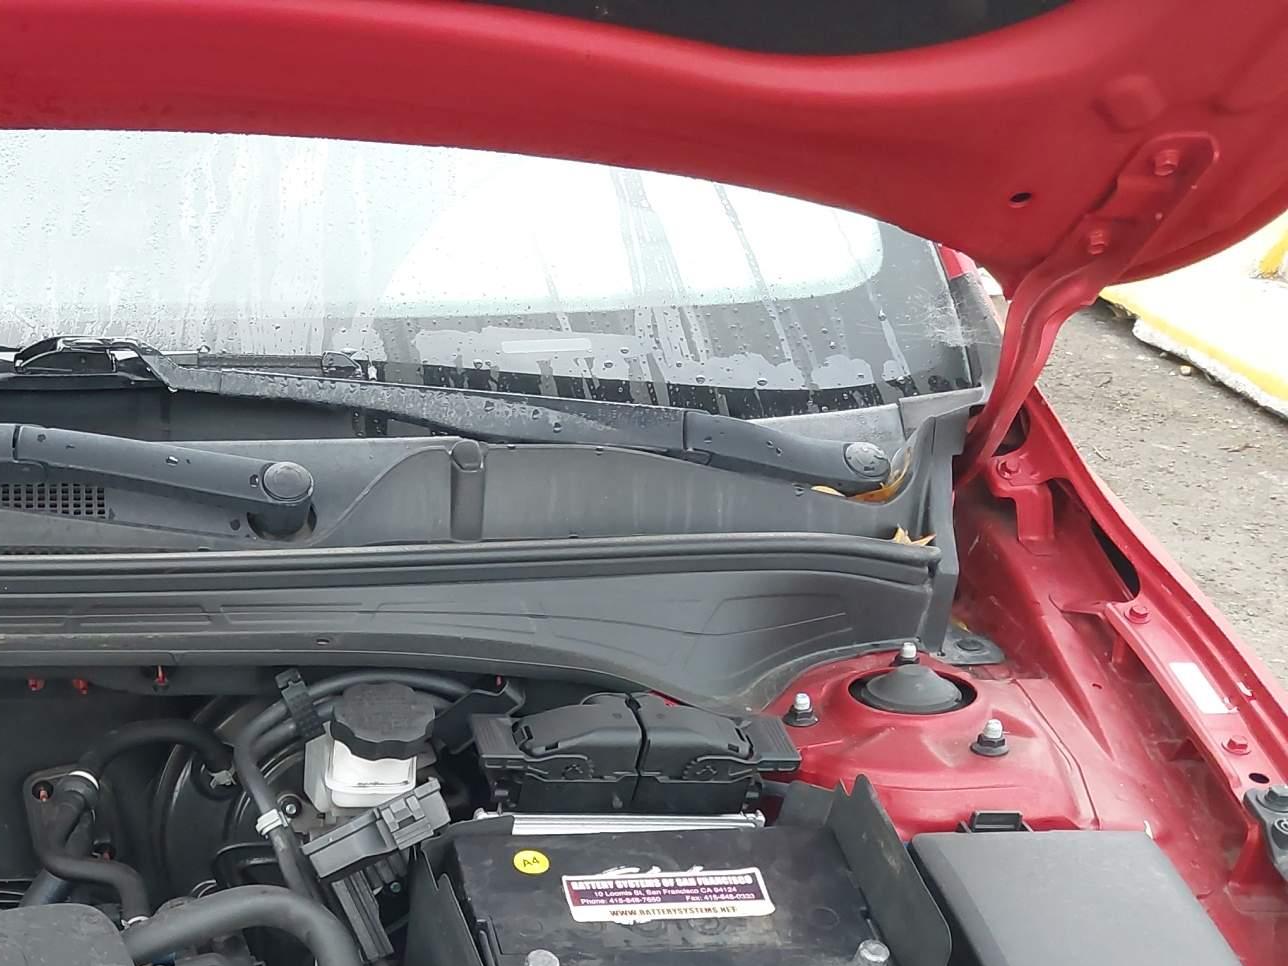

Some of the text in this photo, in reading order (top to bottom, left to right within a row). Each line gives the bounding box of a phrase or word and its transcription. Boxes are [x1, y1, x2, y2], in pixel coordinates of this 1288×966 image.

[571, 875, 753, 891] BATTERY SYSTEMS OF SAN FRANCISCO
[662, 887, 699, 896] Francisco
